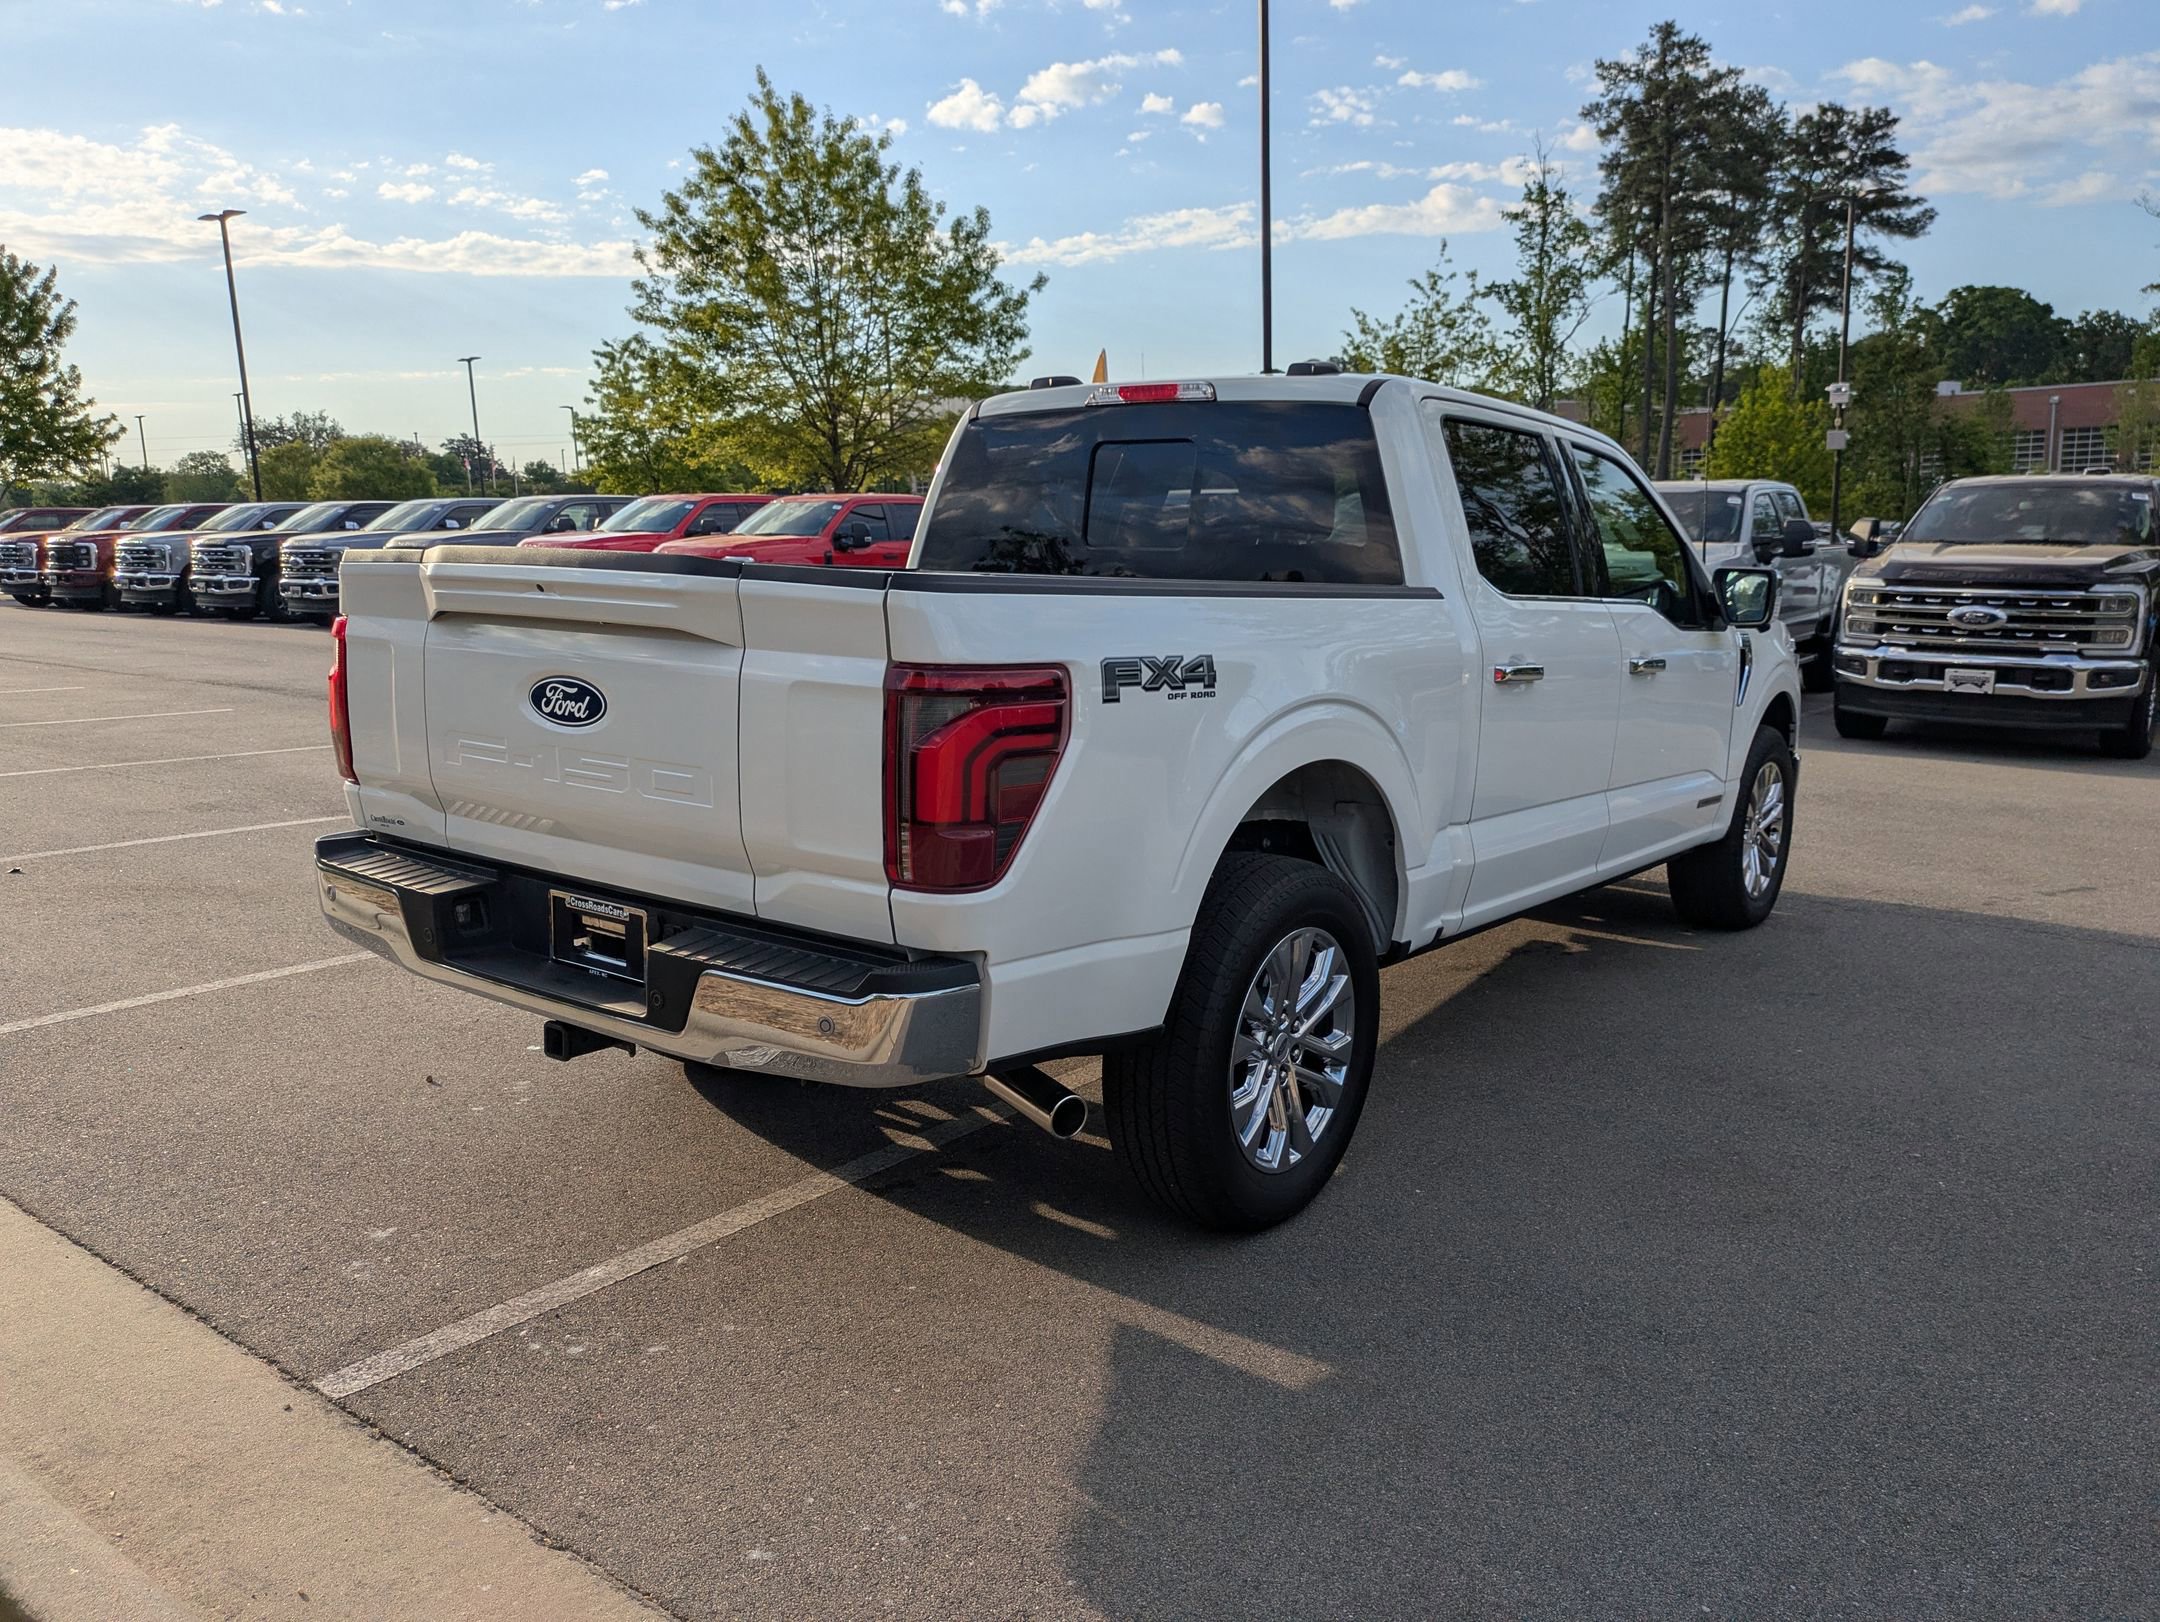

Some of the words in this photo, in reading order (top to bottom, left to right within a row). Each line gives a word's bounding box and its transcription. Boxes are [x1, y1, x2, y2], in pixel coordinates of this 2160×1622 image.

[1100, 655, 1217, 704] FX4
[1167, 692, 1188, 700] OFF
[1190, 691, 1216, 699] ROAD
[541, 683, 591, 719] Ford
[443, 729, 714, 809] F-150
